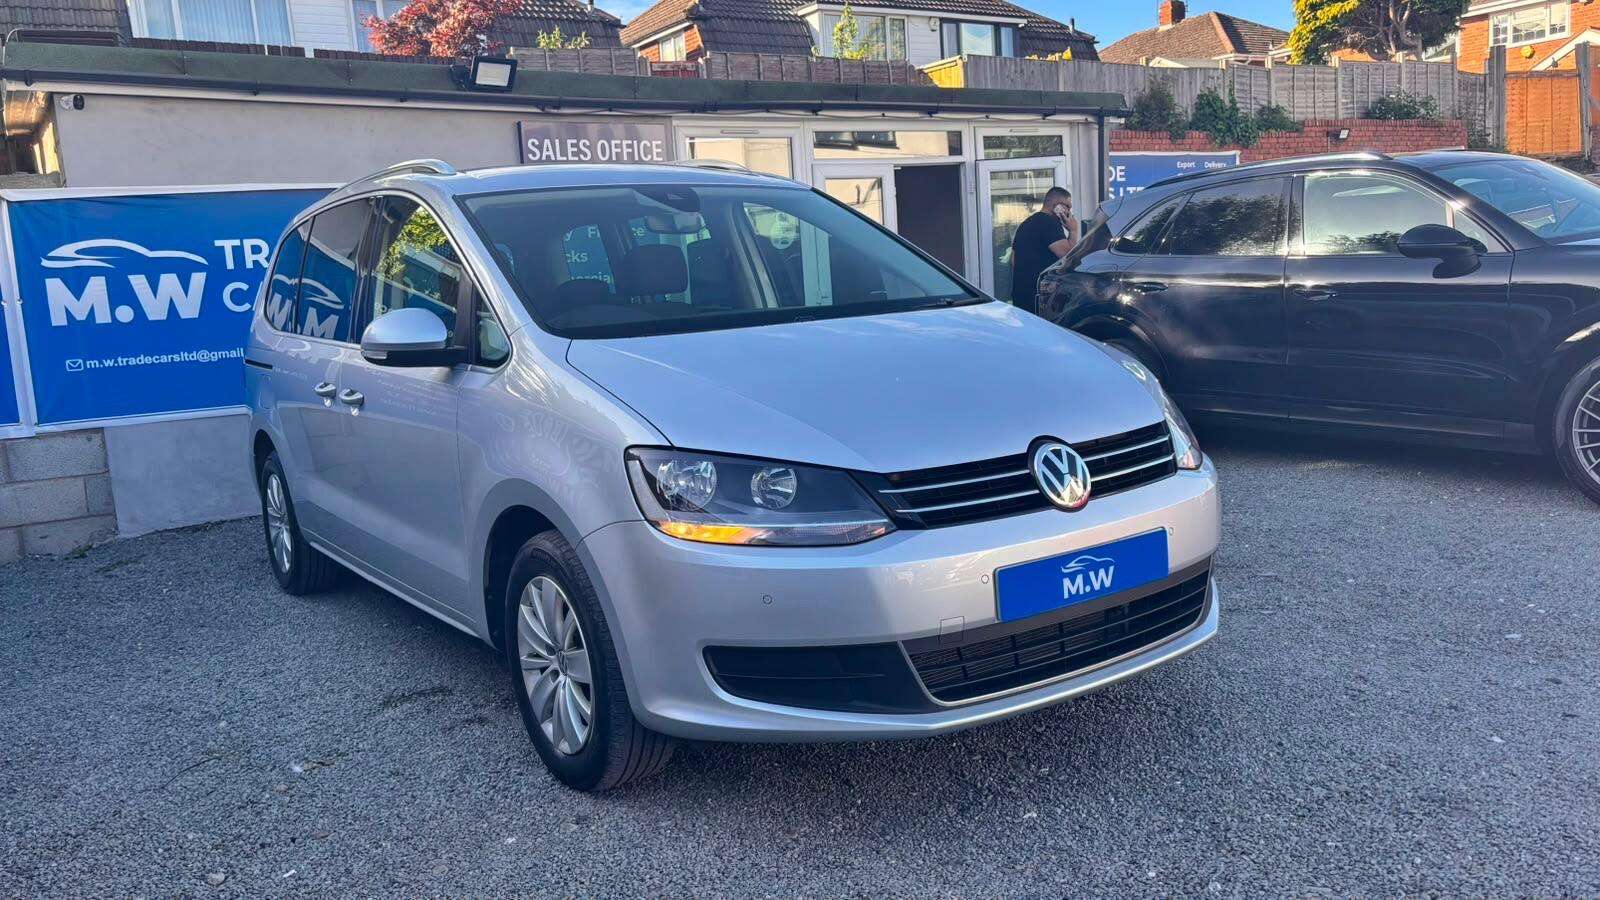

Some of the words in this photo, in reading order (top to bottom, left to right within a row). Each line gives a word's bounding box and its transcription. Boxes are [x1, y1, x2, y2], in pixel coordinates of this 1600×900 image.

[527, 138, 592, 161] SALES
[597, 139, 664, 162] OFFICE
[1177, 161, 1196, 169] Export
[45, 271, 207, 327] M.W
[222, 281, 264, 313] C
[1063, 566, 1115, 599] M.W
